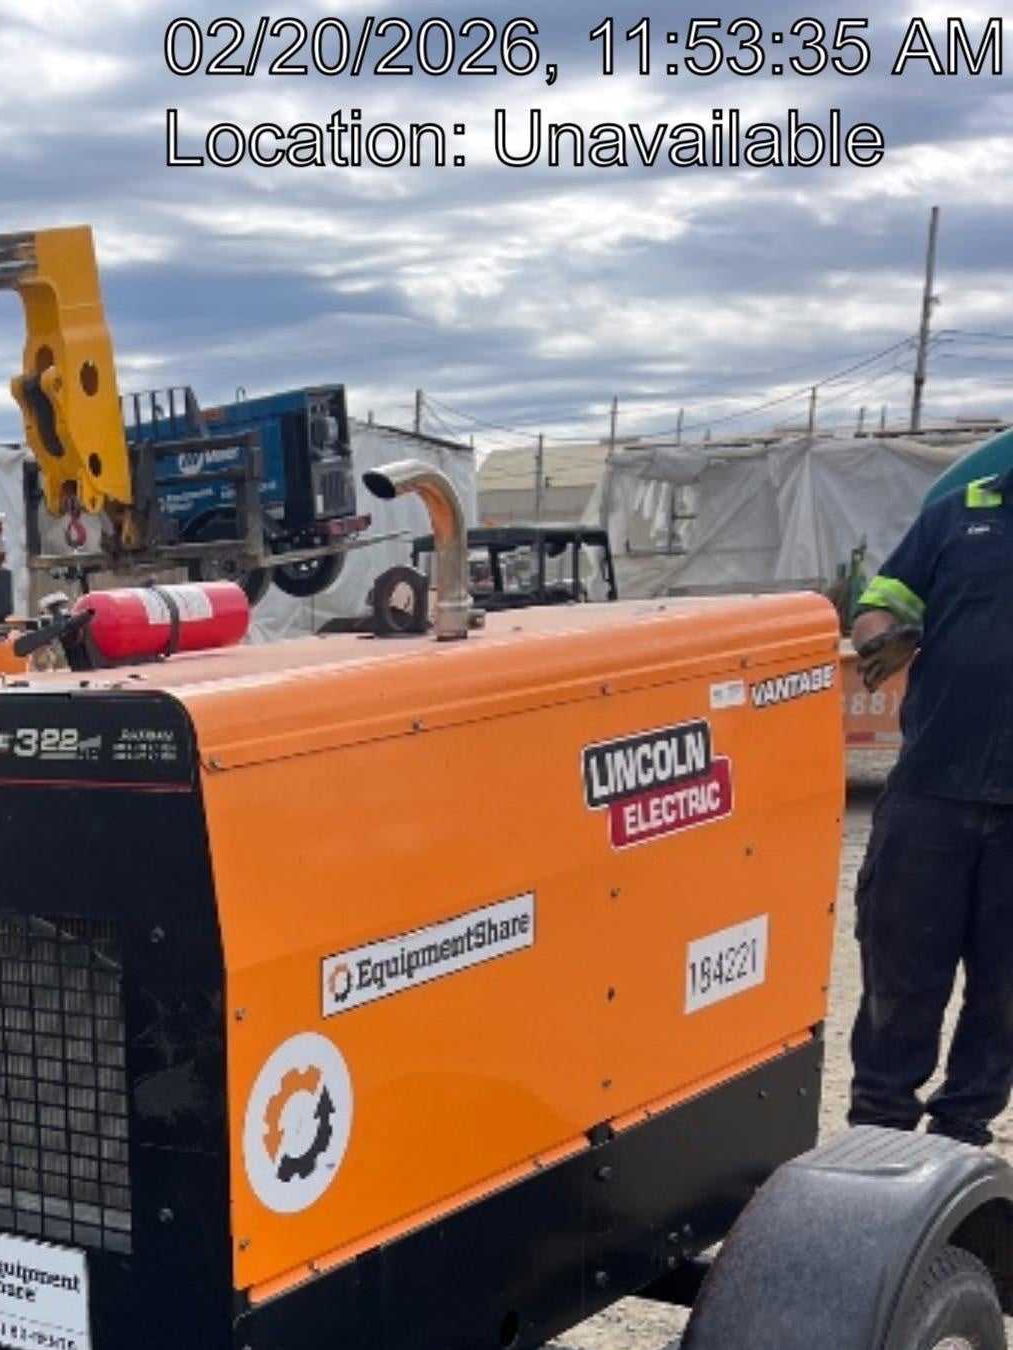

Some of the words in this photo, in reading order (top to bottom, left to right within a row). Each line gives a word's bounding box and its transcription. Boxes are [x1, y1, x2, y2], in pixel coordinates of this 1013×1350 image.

[750, 663, 834, 708] VANTAGE
[589, 731, 706, 799] LINCOLN
[623, 780, 720, 836] ELECTRIC
[356, 912, 532, 990] EquipmentShare
[689, 938, 758, 997] 184221
